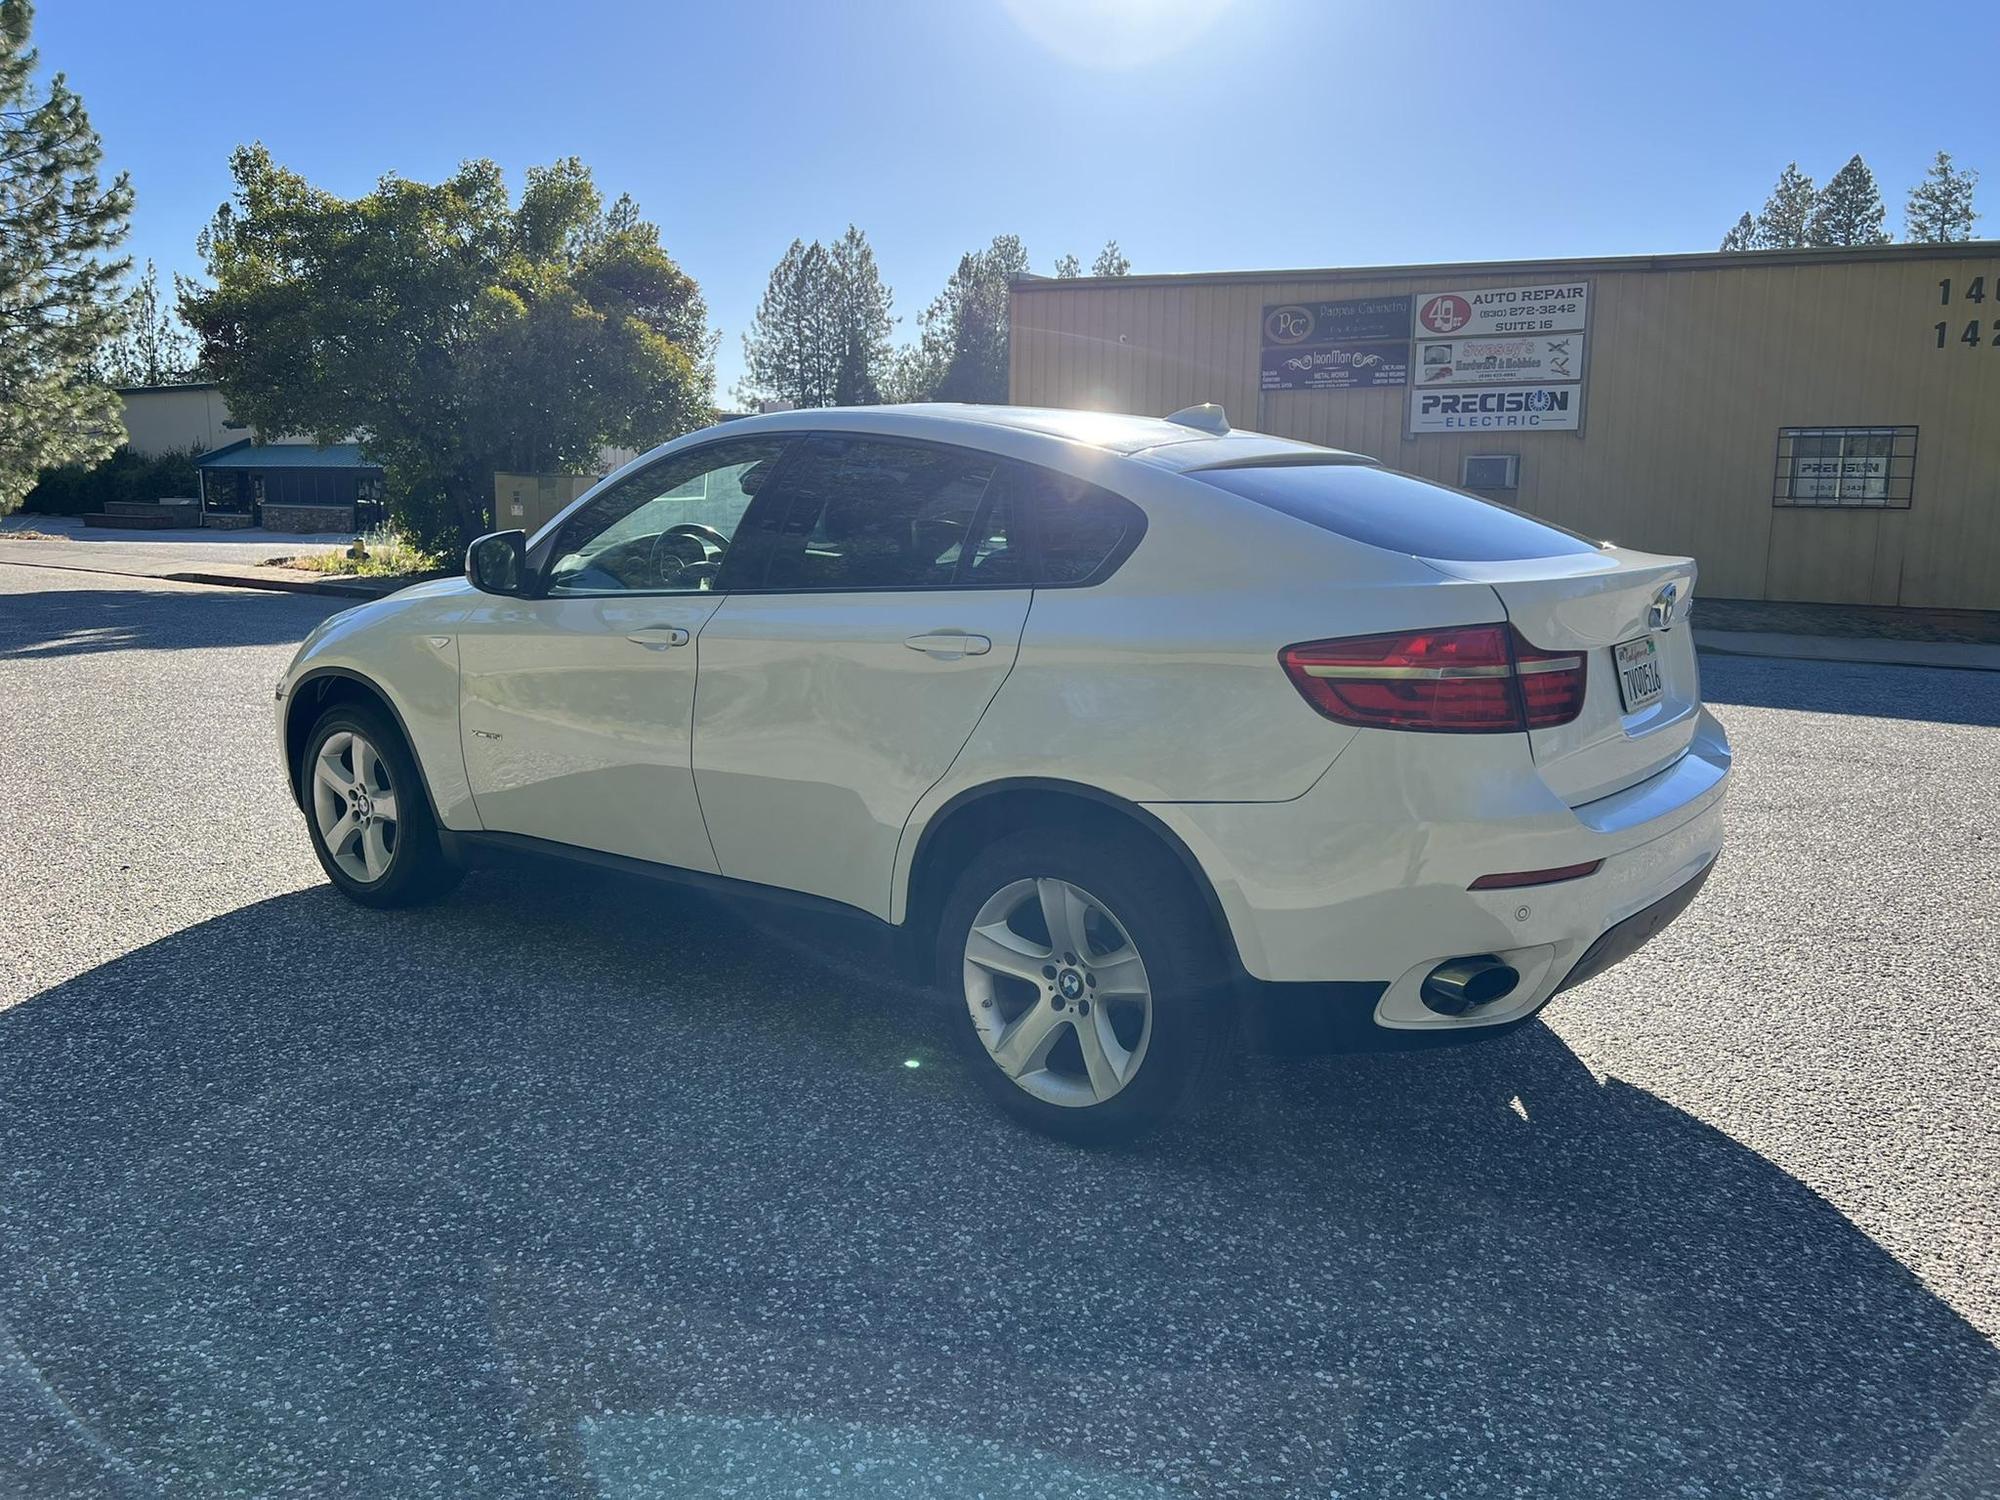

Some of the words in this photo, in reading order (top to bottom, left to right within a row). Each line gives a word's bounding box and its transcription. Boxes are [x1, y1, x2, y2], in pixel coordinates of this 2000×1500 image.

[1472, 292, 1517, 305] AUTO
[1521, 287, 1584, 302] REPAIR
[1939, 276, 2000, 305] 14
[1510, 304, 1576, 317] 272-3242
[1495, 320, 1536, 332] SUITE
[1539, 320, 1553, 330] 16
[1463, 339, 1536, 358] Swasey's
[1505, 357, 1542, 369] Hobbies
[1421, 389, 1569, 414] PRECISION
[1446, 415, 1540, 428] ELECTRIC
